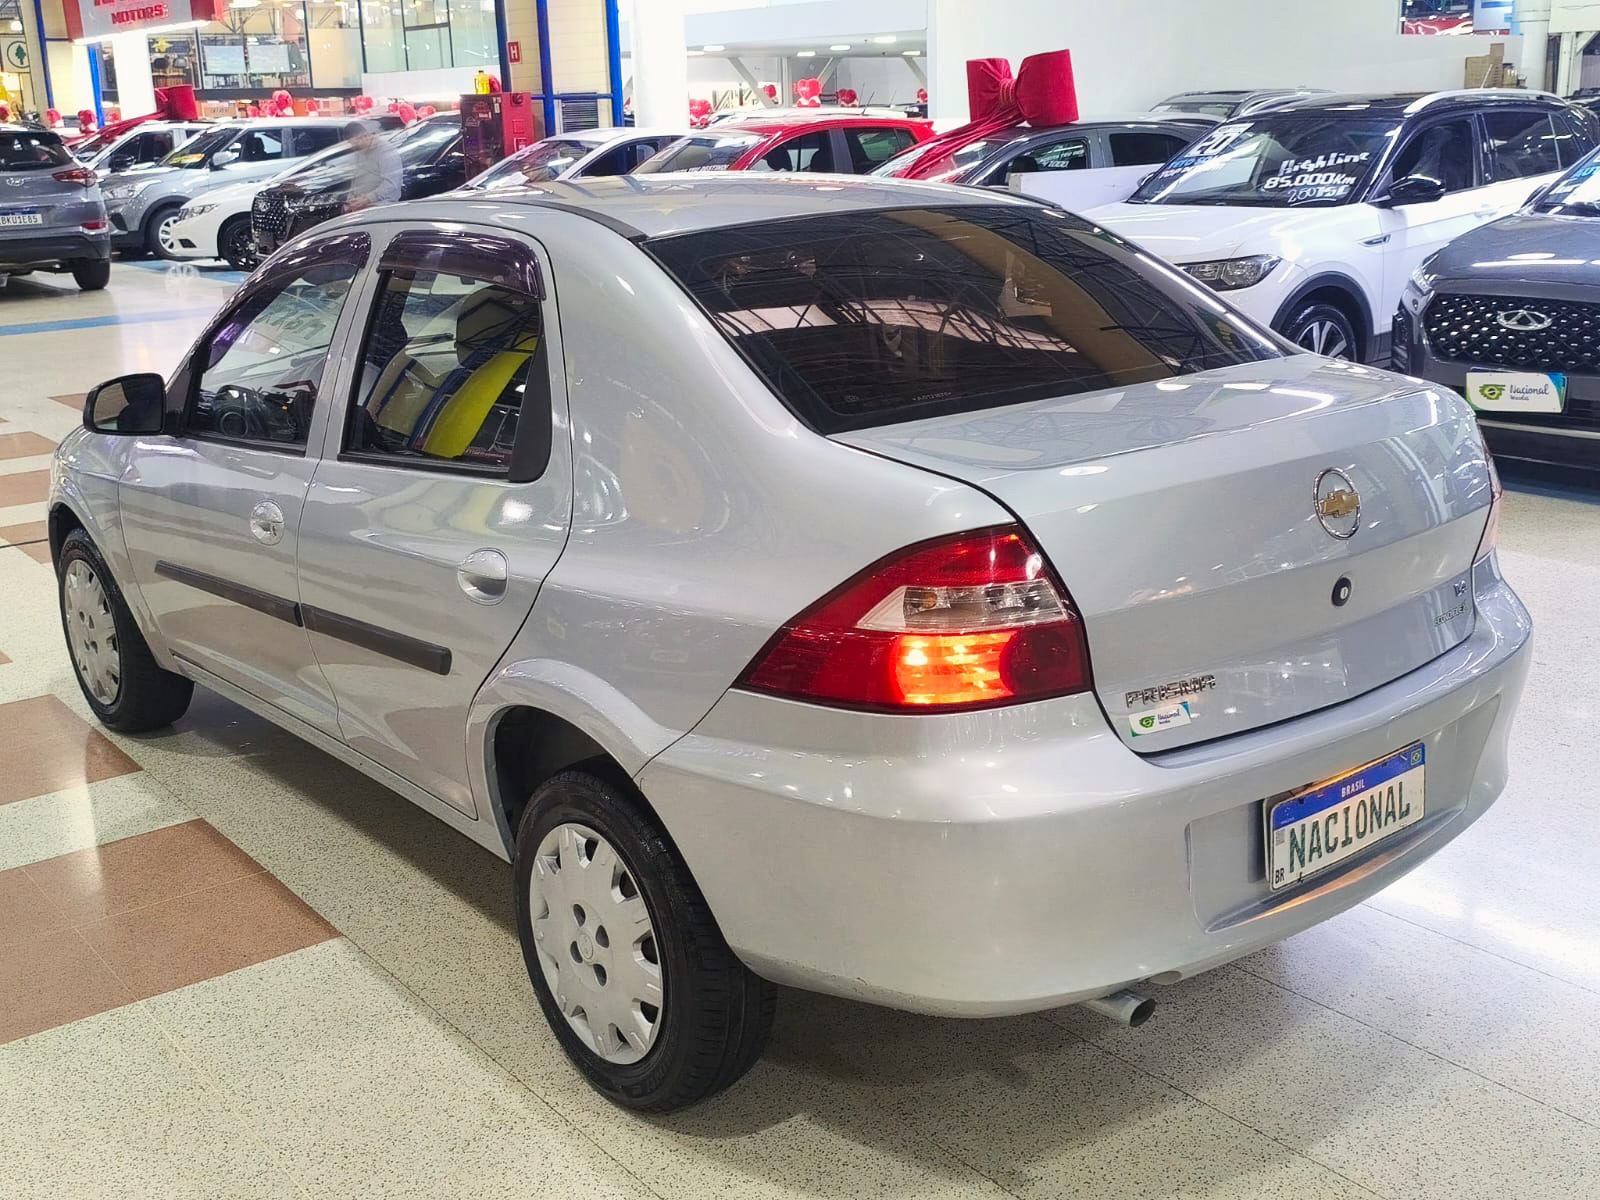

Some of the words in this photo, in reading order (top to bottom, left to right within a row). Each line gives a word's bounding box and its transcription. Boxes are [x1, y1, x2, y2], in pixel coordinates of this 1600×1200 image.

[111, 4, 166, 24] MOTORS
[510, 44, 519, 60] H
[1509, 383, 1549, 395] Nacional
[1125, 674, 1216, 708] PRISMA
[1341, 779, 1365, 799] BRASIL
[1289, 781, 1411, 873] NACIONAL
[1275, 867, 1285, 884] BR
